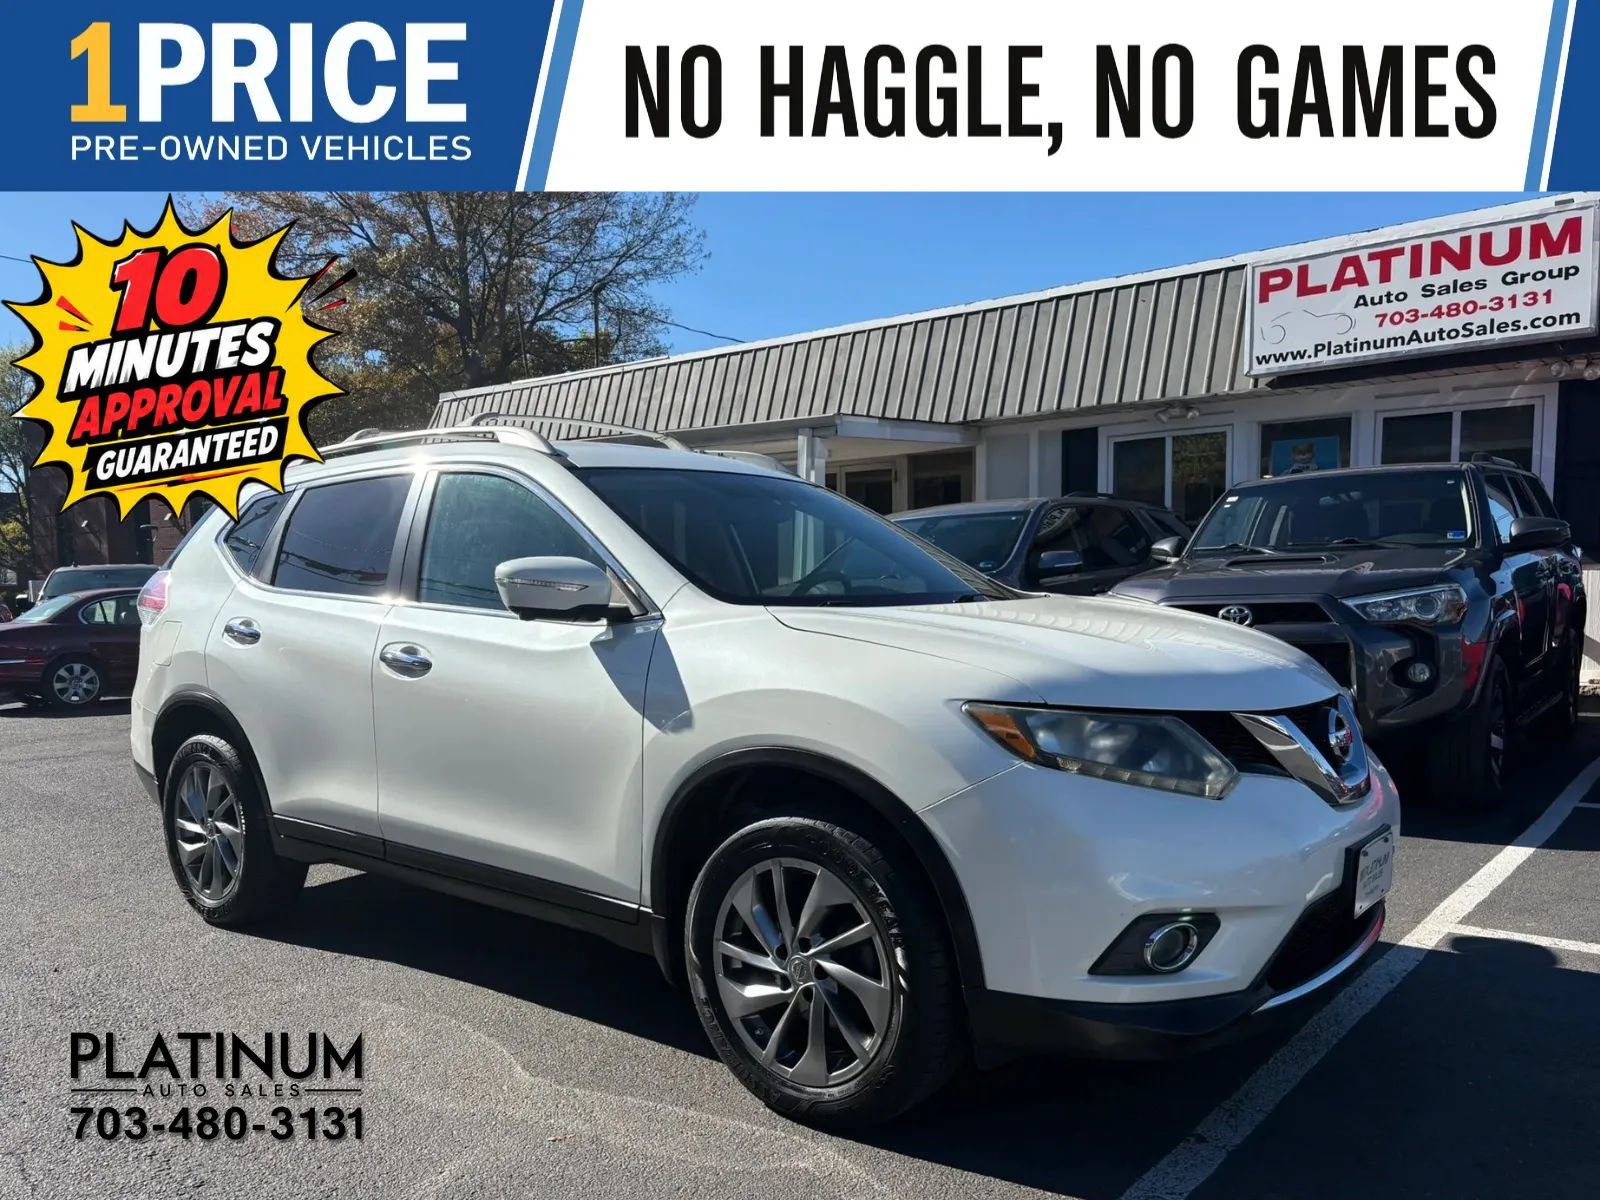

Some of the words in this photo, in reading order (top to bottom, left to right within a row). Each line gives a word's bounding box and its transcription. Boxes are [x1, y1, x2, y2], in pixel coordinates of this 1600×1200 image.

[1258, 216, 1583, 304] PLATINUM
[1353, 290, 1408, 309] Auto
[1421, 278, 1487, 298] Sales
[1501, 265, 1580, 286] Group
[1375, 289, 1553, 328] 703-480-3131
[1255, 311, 1581, 365] www.PlatinumAutoSales.com
